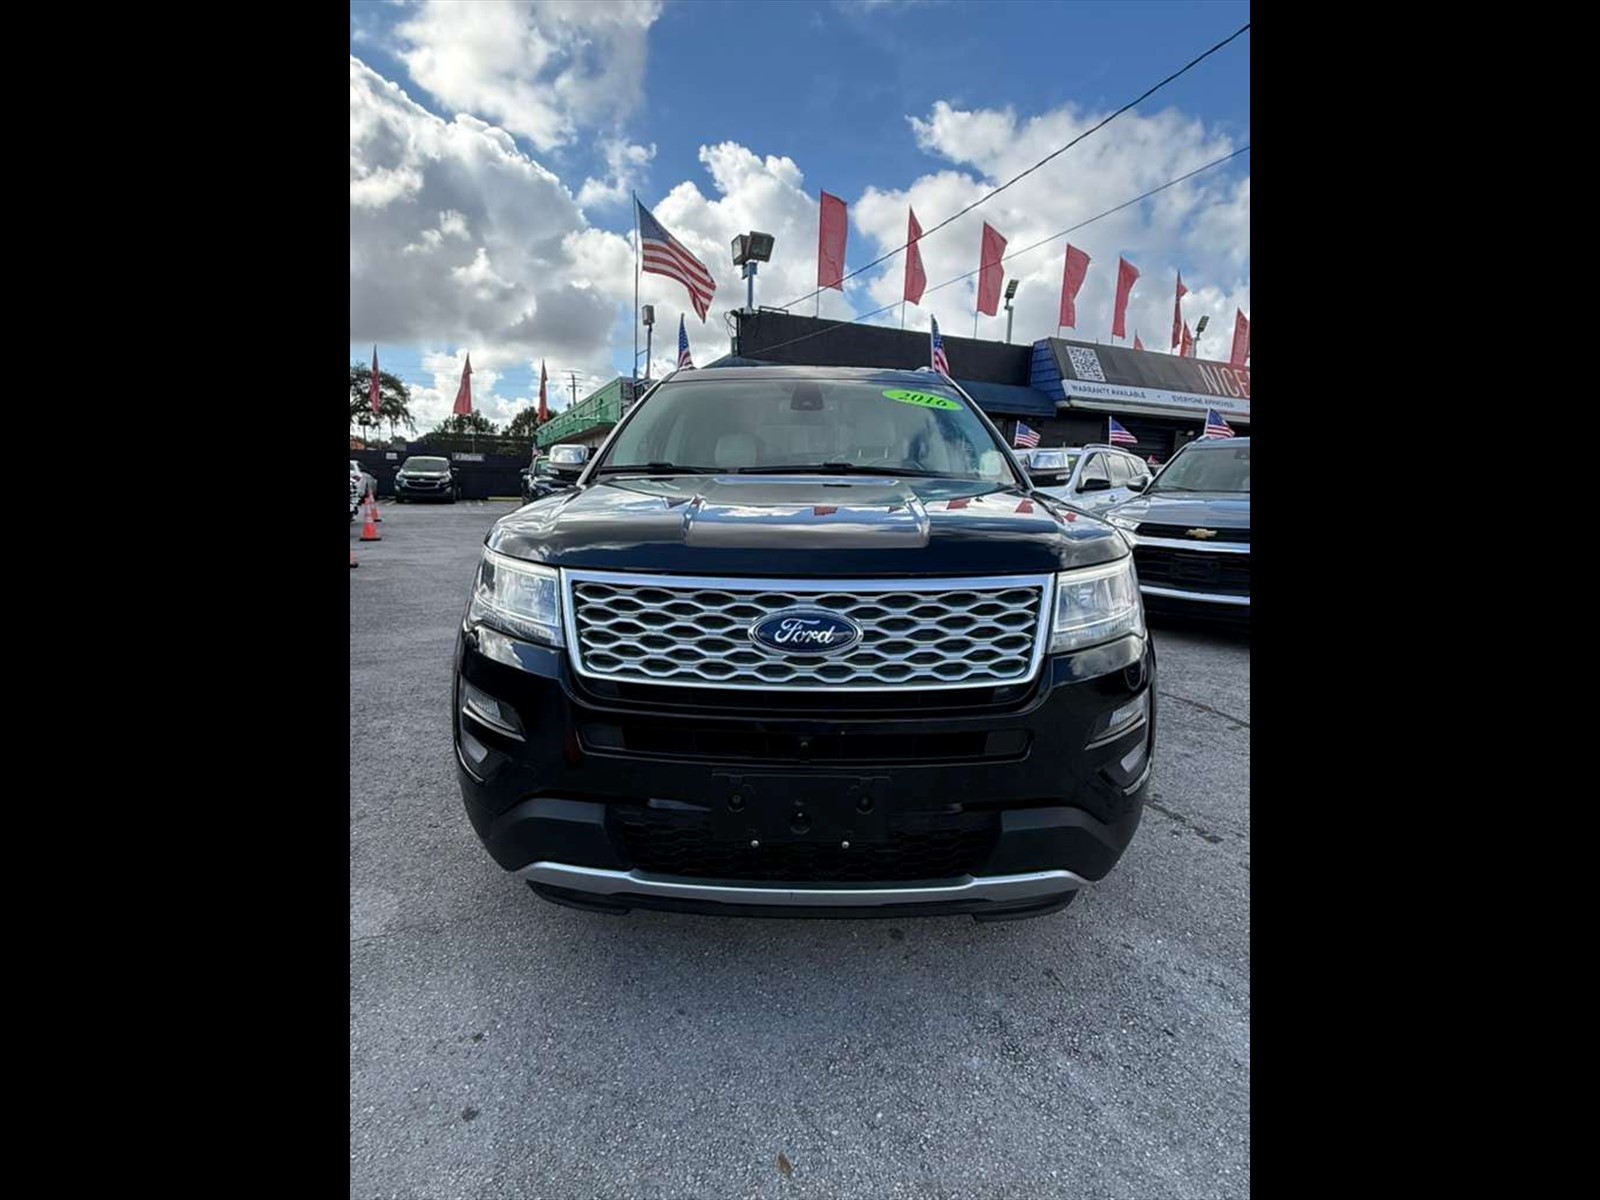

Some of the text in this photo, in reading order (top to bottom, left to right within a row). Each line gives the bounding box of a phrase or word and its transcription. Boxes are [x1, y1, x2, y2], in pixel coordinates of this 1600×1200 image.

[1071, 384, 1146, 399] WARRANTY AVAILABLE
[898, 392, 948, 407] 2016
[774, 617, 836, 644] Ford
